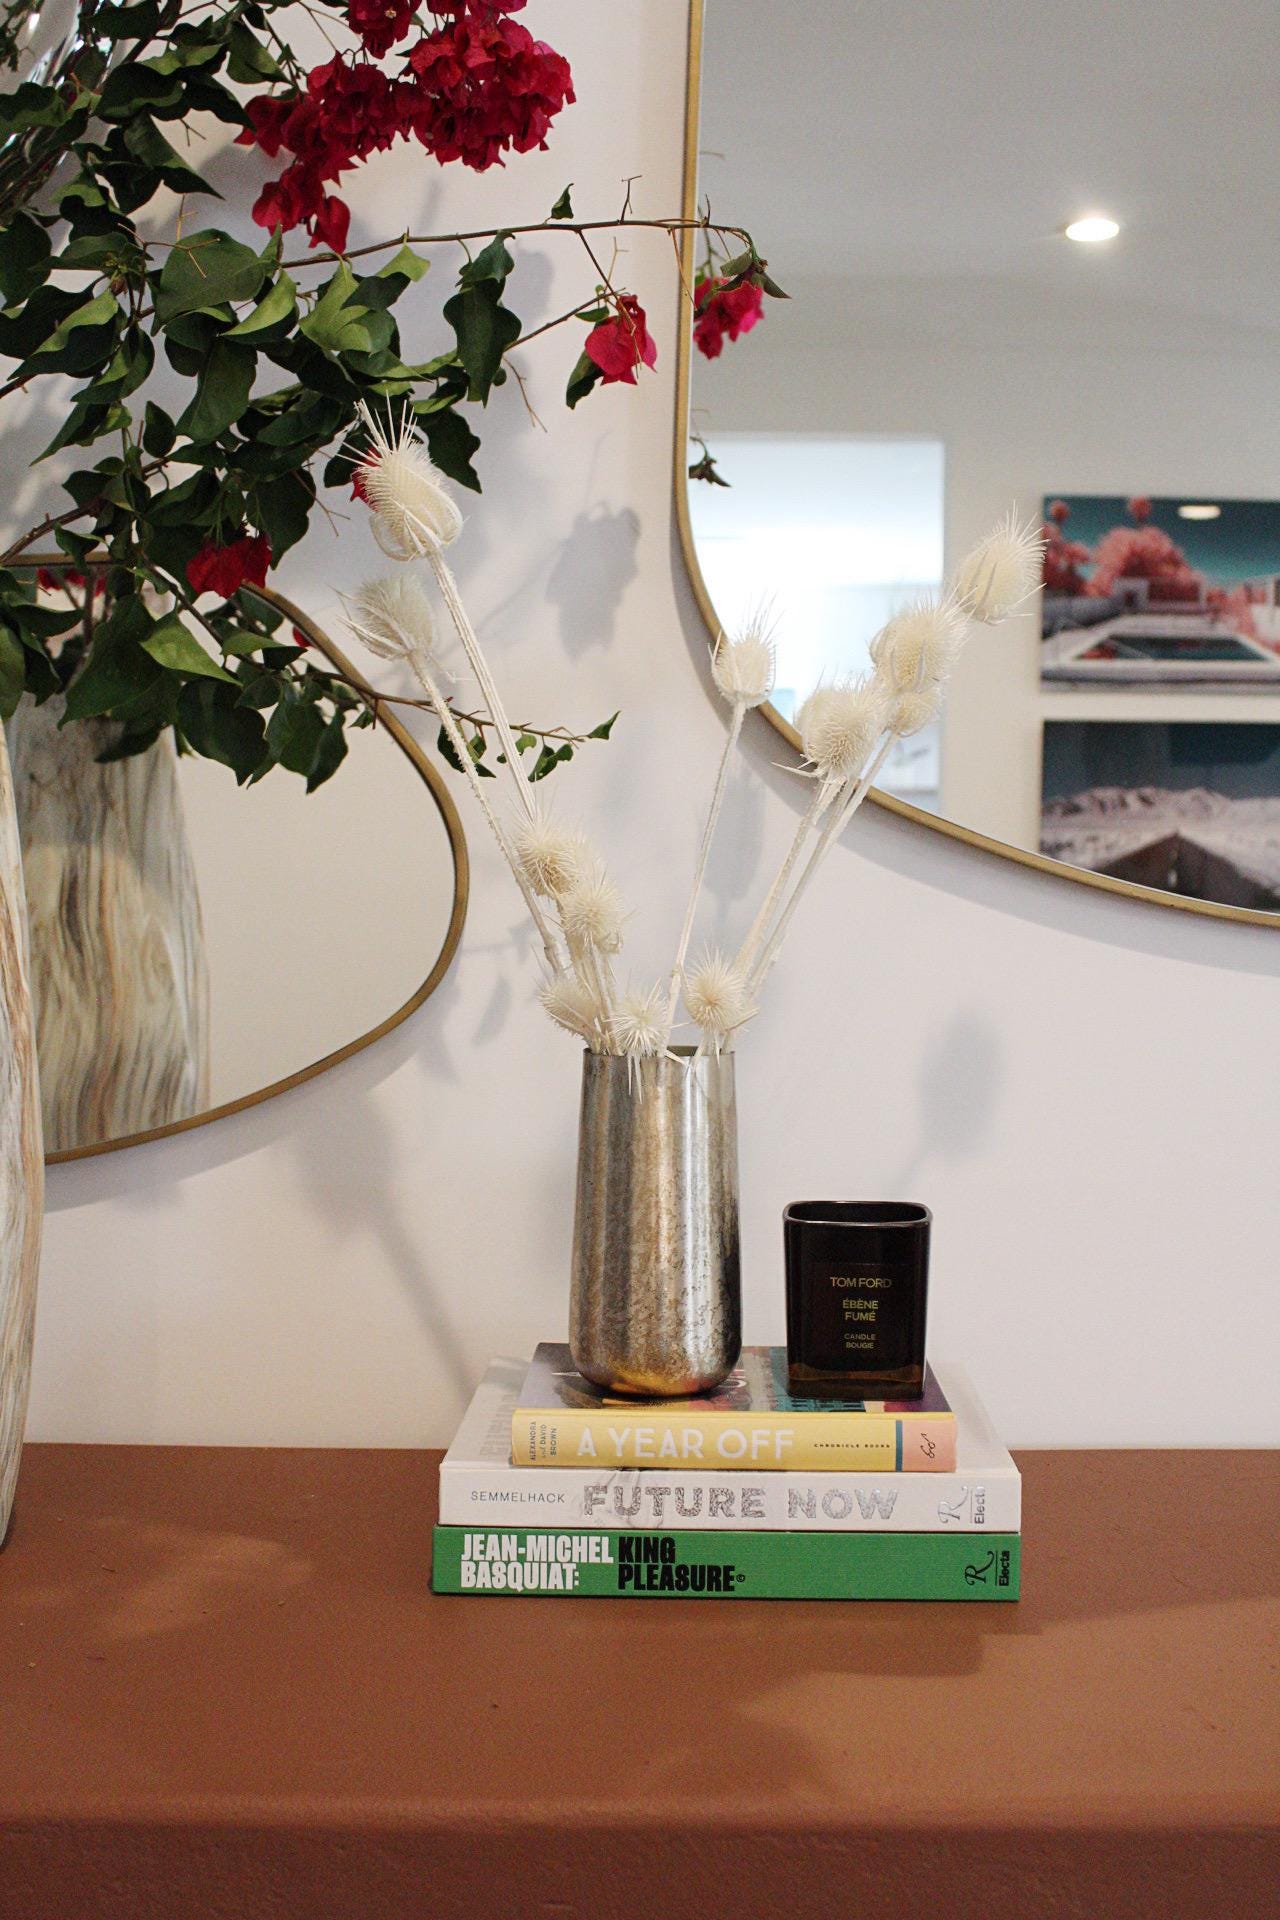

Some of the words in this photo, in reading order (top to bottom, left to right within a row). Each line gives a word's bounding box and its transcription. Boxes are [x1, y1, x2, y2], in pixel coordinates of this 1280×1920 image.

[829, 1277, 857, 1288] TOM
[858, 1277, 892, 1288] FORD
[842, 1298, 879, 1310] ÉBÈNE
[845, 1310, 876, 1322] FUMÉ
[844, 1333, 876, 1341] CANDLE
[539, 1424, 548, 1445] DAVID
[549, 1427, 558, 1457] BROWN
[577, 1427, 597, 1457] A
[608, 1427, 704, 1459] YEAR
[717, 1428, 795, 1460] OFF
[470, 1490, 566, 1504] SEMMELHACK
[583, 1484, 767, 1520] FUTURE
[787, 1487, 899, 1520] NOW
[461, 1533, 615, 1564] JEAN-MICHEL
[618, 1536, 677, 1564] KING
[460, 1560, 580, 1593] BASQUIAT:
[998, 1550, 1010, 1587] Electa
